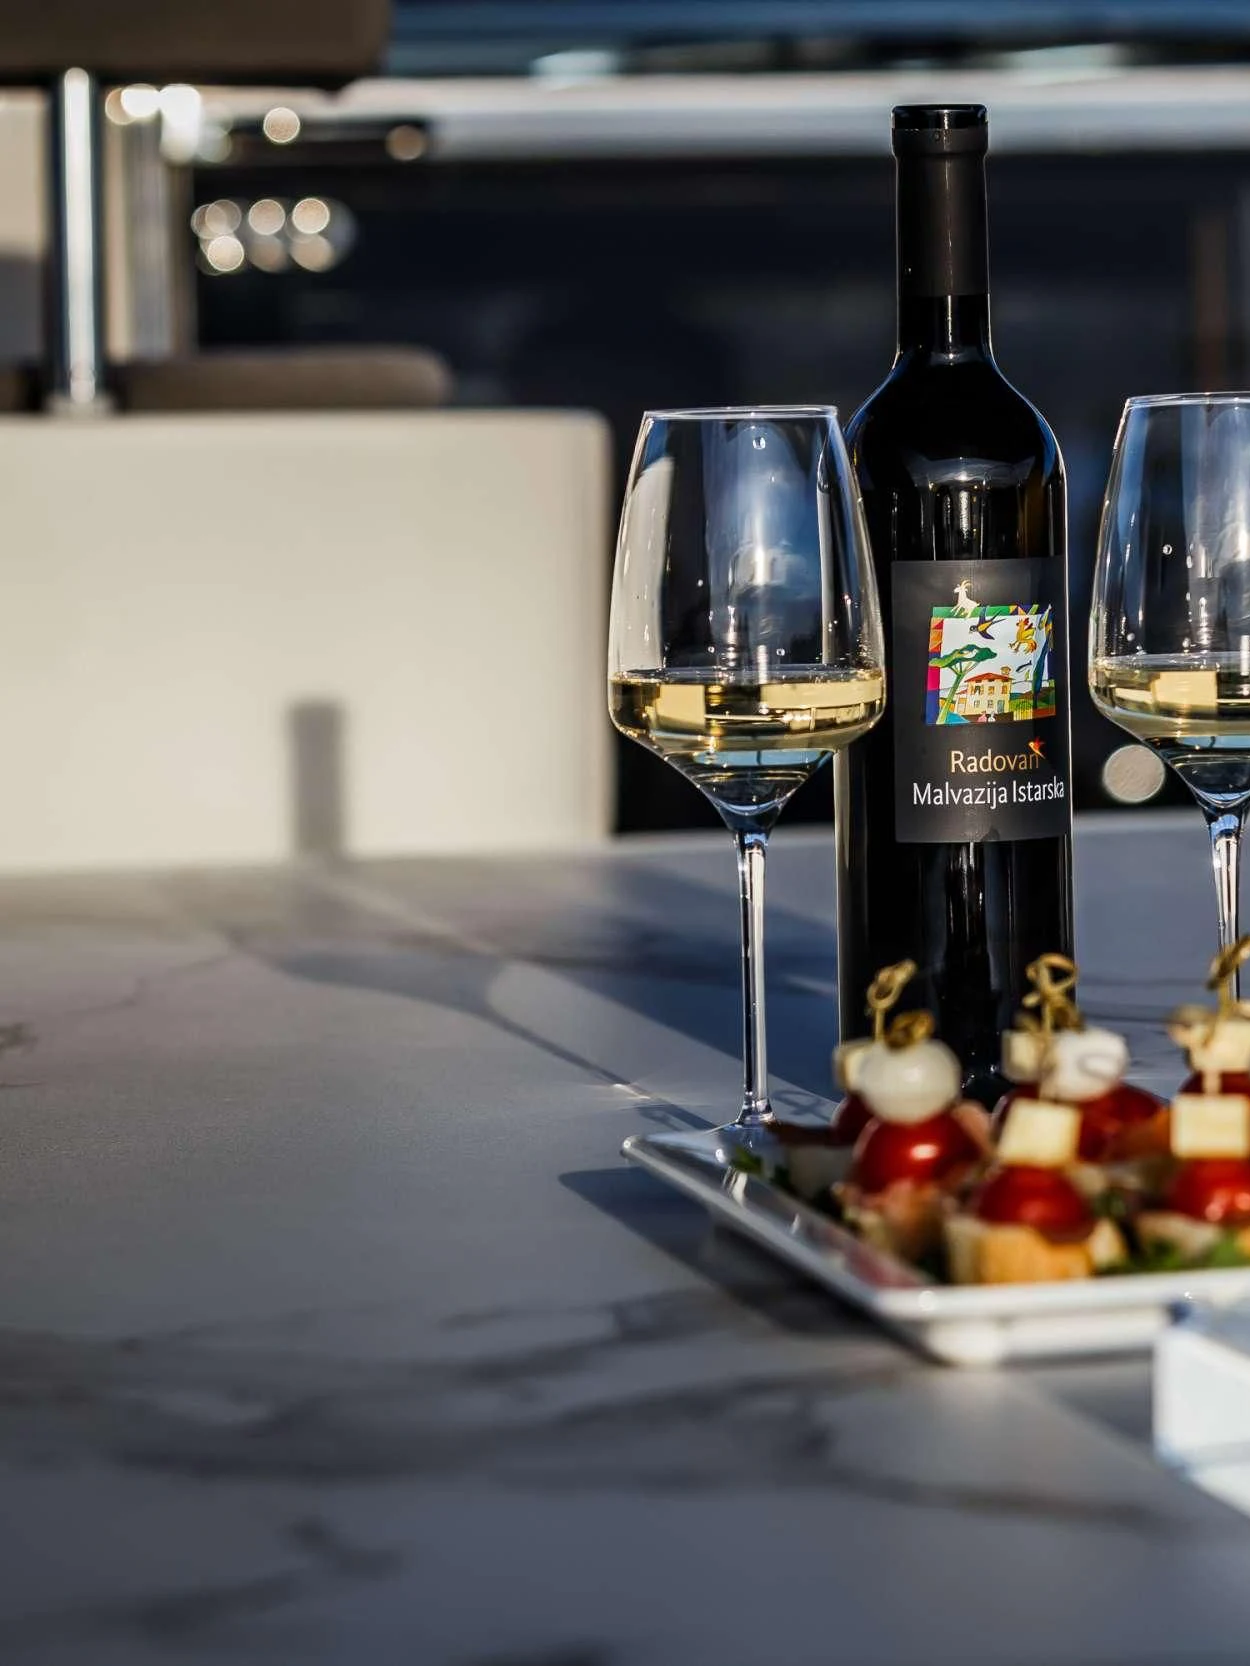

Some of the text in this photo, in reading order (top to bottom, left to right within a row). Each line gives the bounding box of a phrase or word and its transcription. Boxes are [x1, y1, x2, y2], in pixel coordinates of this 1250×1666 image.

[950, 749, 1039, 773] Radovan
[913, 775, 1065, 810] Malvazija Istarska
